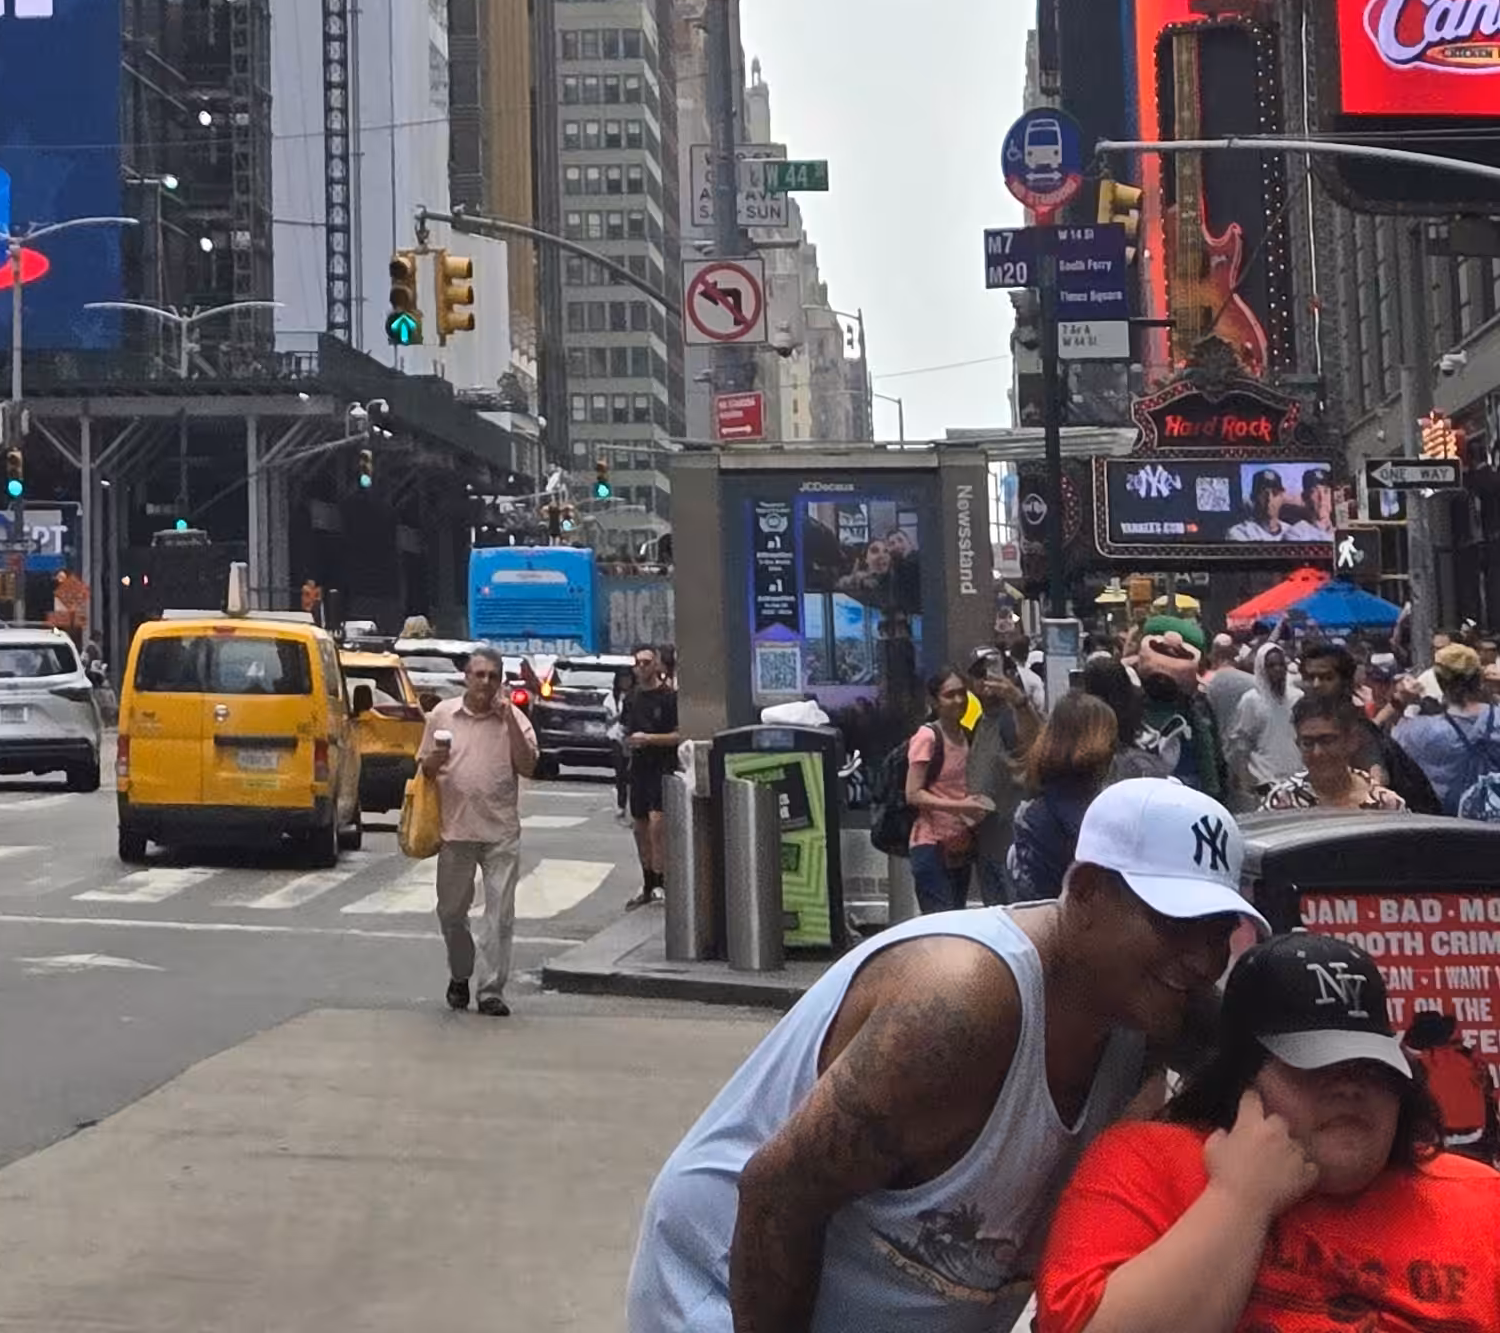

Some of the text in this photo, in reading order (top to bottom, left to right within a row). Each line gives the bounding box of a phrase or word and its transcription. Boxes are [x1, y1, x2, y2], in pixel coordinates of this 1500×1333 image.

[785, 164, 808, 188] 44
[746, 205, 781, 220] SUN
[988, 233, 1013, 254] M7
[989, 262, 1028, 284] M20
[1059, 260, 1112, 273] South Ferry
[1060, 290, 1122, 303] Times Square
[1165, 415, 1273, 441] Hard Rock
[1380, 468, 1448, 481] ONE WAY
[957, 485, 977, 594] Newsstand
[1191, 814, 1230, 872] NY
[1300, 898, 1358, 925] JAM
[1379, 897, 1442, 923] BAD
[1306, 961, 1369, 1018] NY
[1445, 965, 1491, 990] WANT
[1452, 997, 1493, 1022] THE
